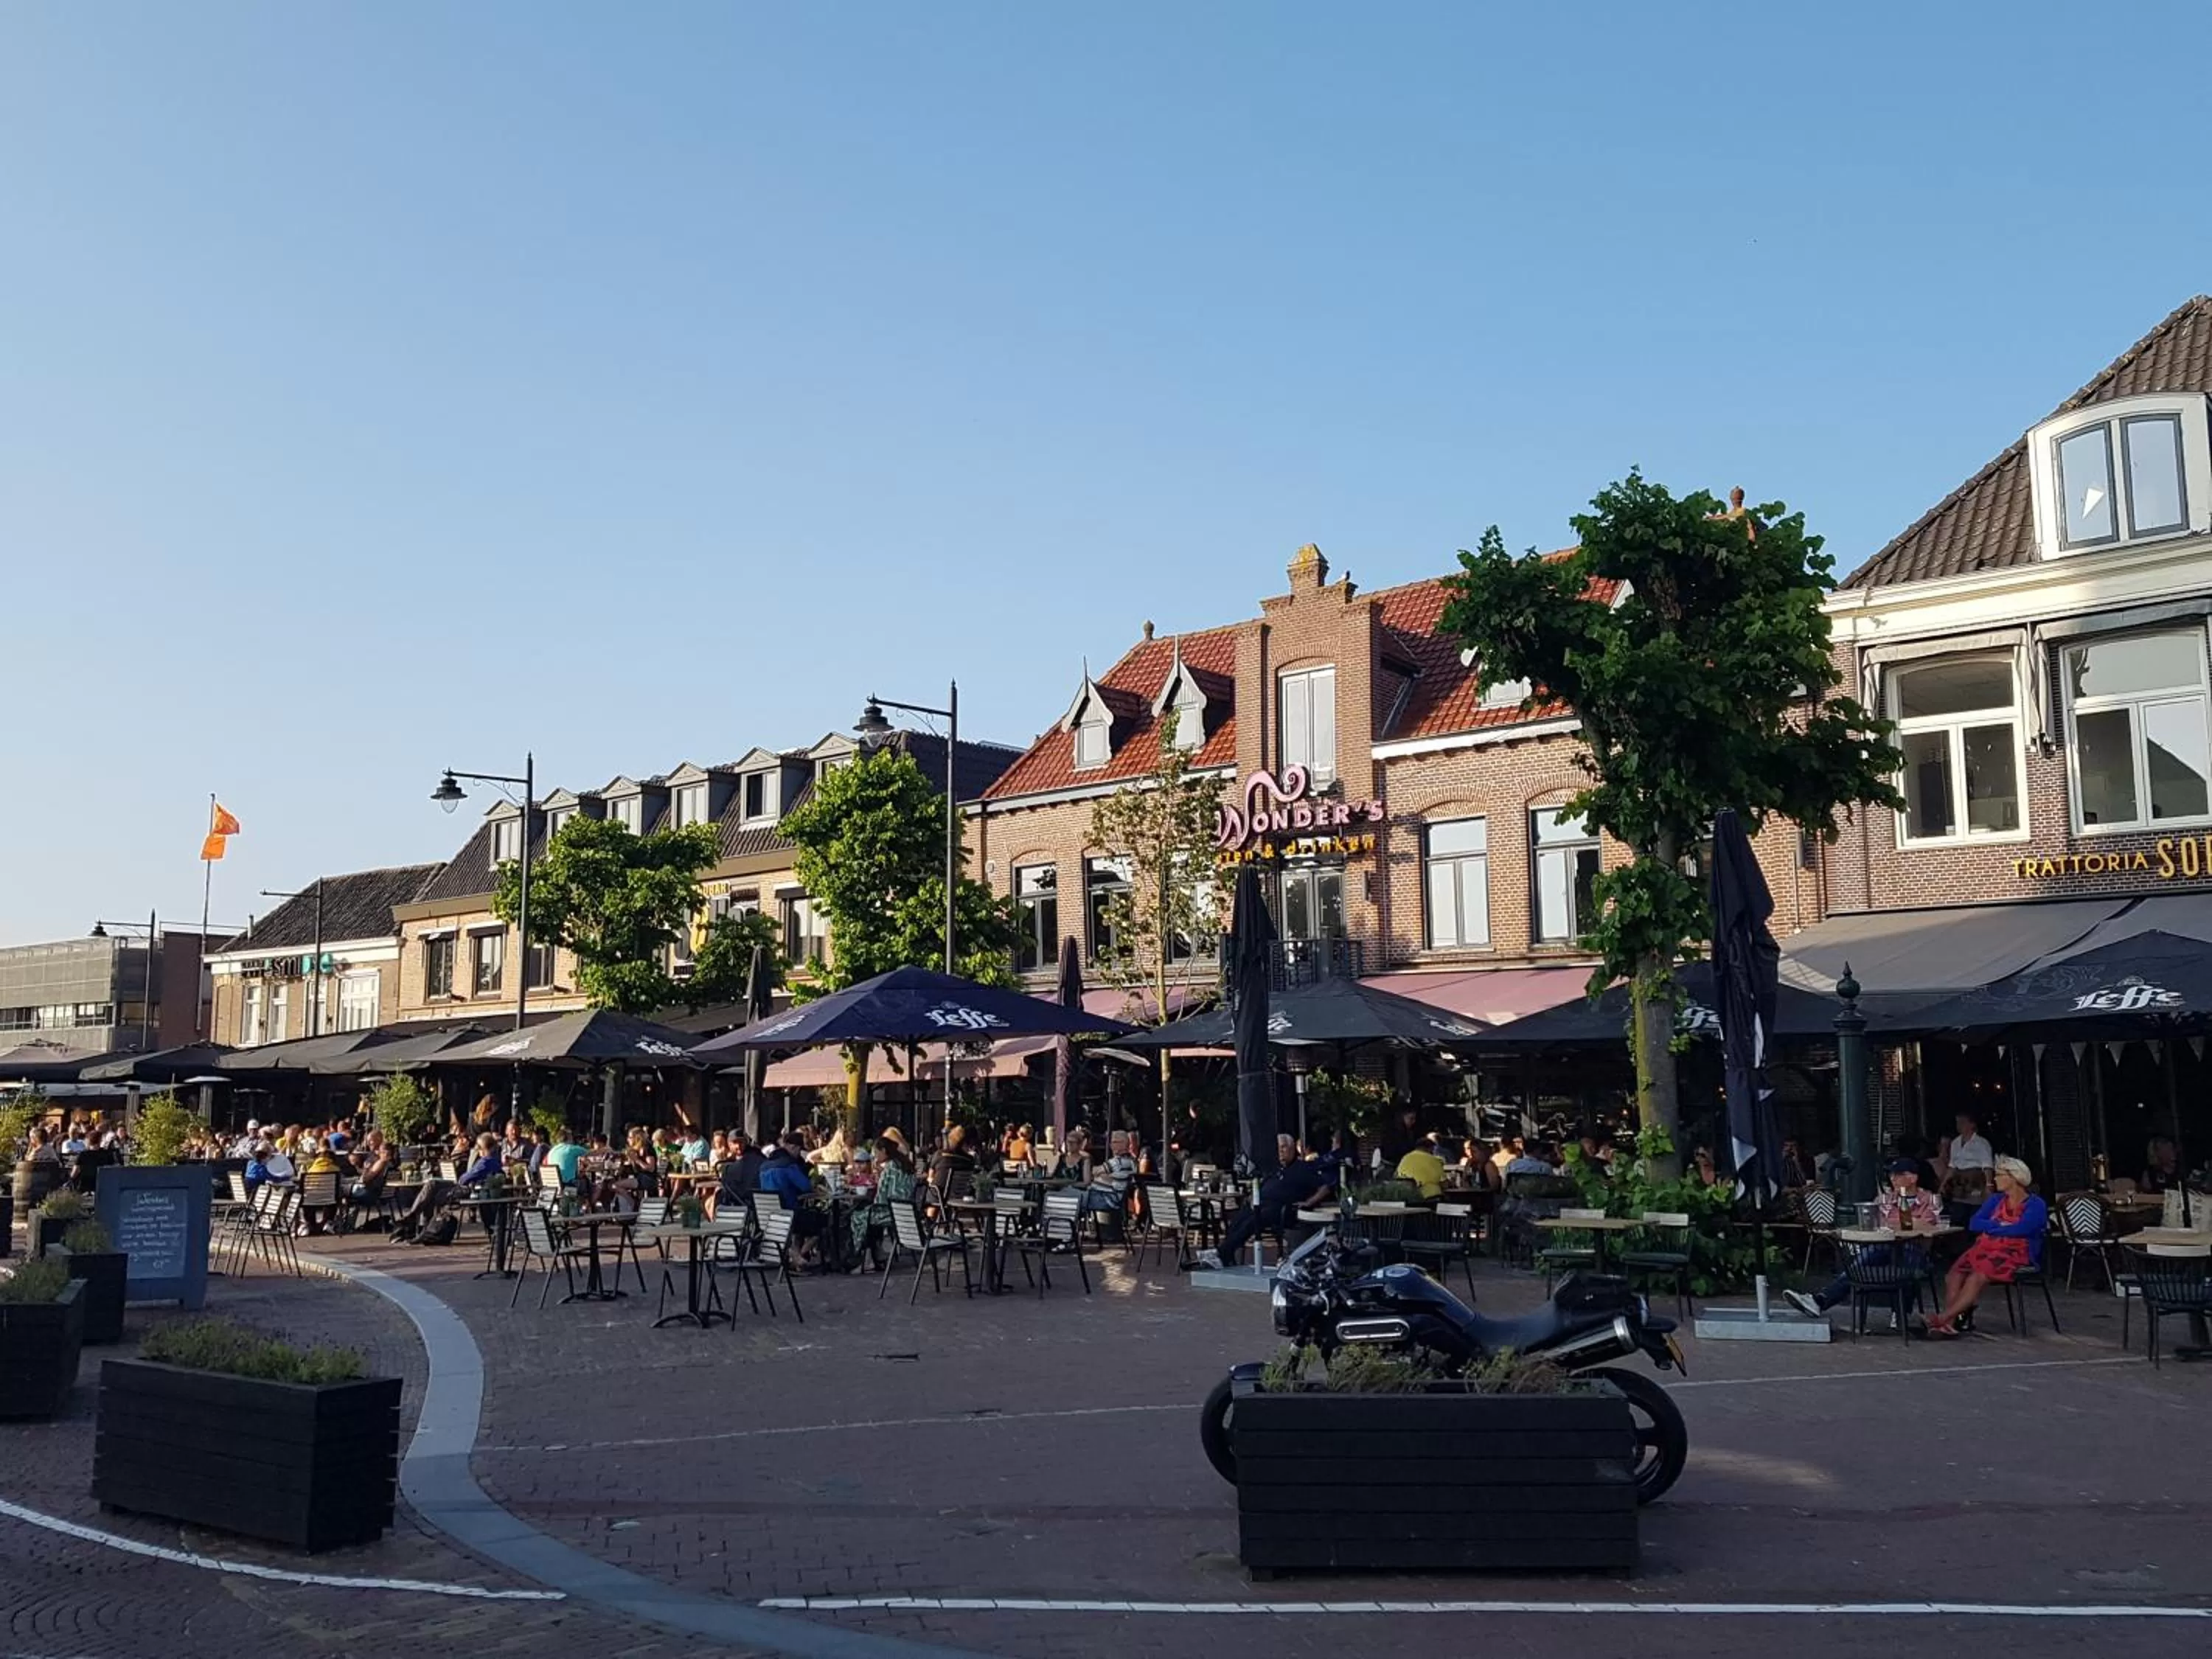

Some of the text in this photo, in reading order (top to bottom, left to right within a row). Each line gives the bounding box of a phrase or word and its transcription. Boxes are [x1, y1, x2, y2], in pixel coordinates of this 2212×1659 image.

[1264, 843, 1276, 860] &
[1286, 834, 1376, 856] drinken
[2013, 852, 2150, 878] TRATTORIA
[2067, 984, 2183, 1012] Leffe
[924, 1008, 999, 1030] Leffe
